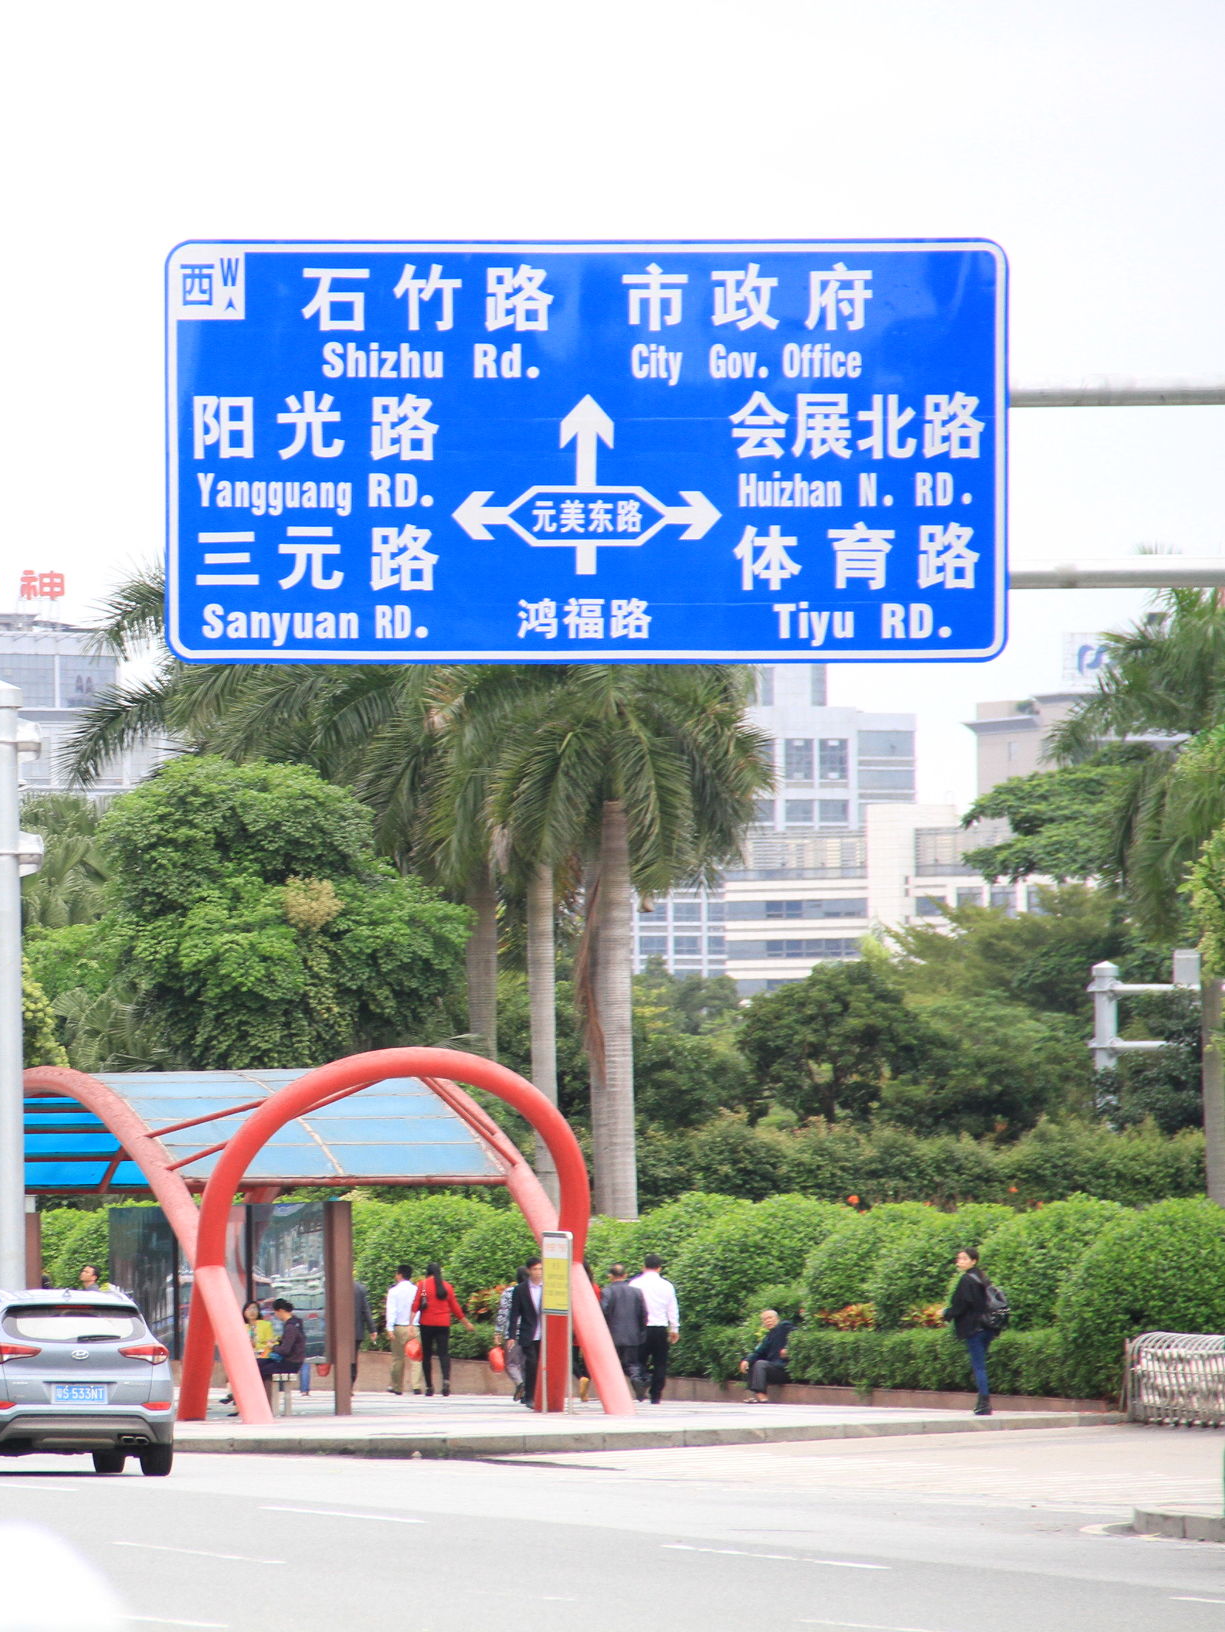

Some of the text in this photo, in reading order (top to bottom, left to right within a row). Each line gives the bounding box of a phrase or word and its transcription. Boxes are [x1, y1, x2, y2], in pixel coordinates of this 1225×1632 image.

[180, 257, 240, 306] 西 W
[302, 263, 554, 331] 石竹路
[621, 262, 873, 332] 市政府
[322, 342, 540, 378] Shizhu Rd.
[631, 342, 862, 386] City Gov. Office
[193, 391, 440, 460] 阳光路
[729, 391, 985, 460] 会展北路
[197, 473, 434, 516] Yangguang RD.
[738, 471, 972, 507] Huizhan N. RD.
[532, 499, 643, 533] 元美东路
[195, 523, 439, 591] 三元路
[733, 522, 980, 591] 体育路
[202, 603, 429, 646] Sanyuan RD.
[517, 597, 652, 640] 鸿福路
[773, 602, 952, 646] Tiyu RD.
